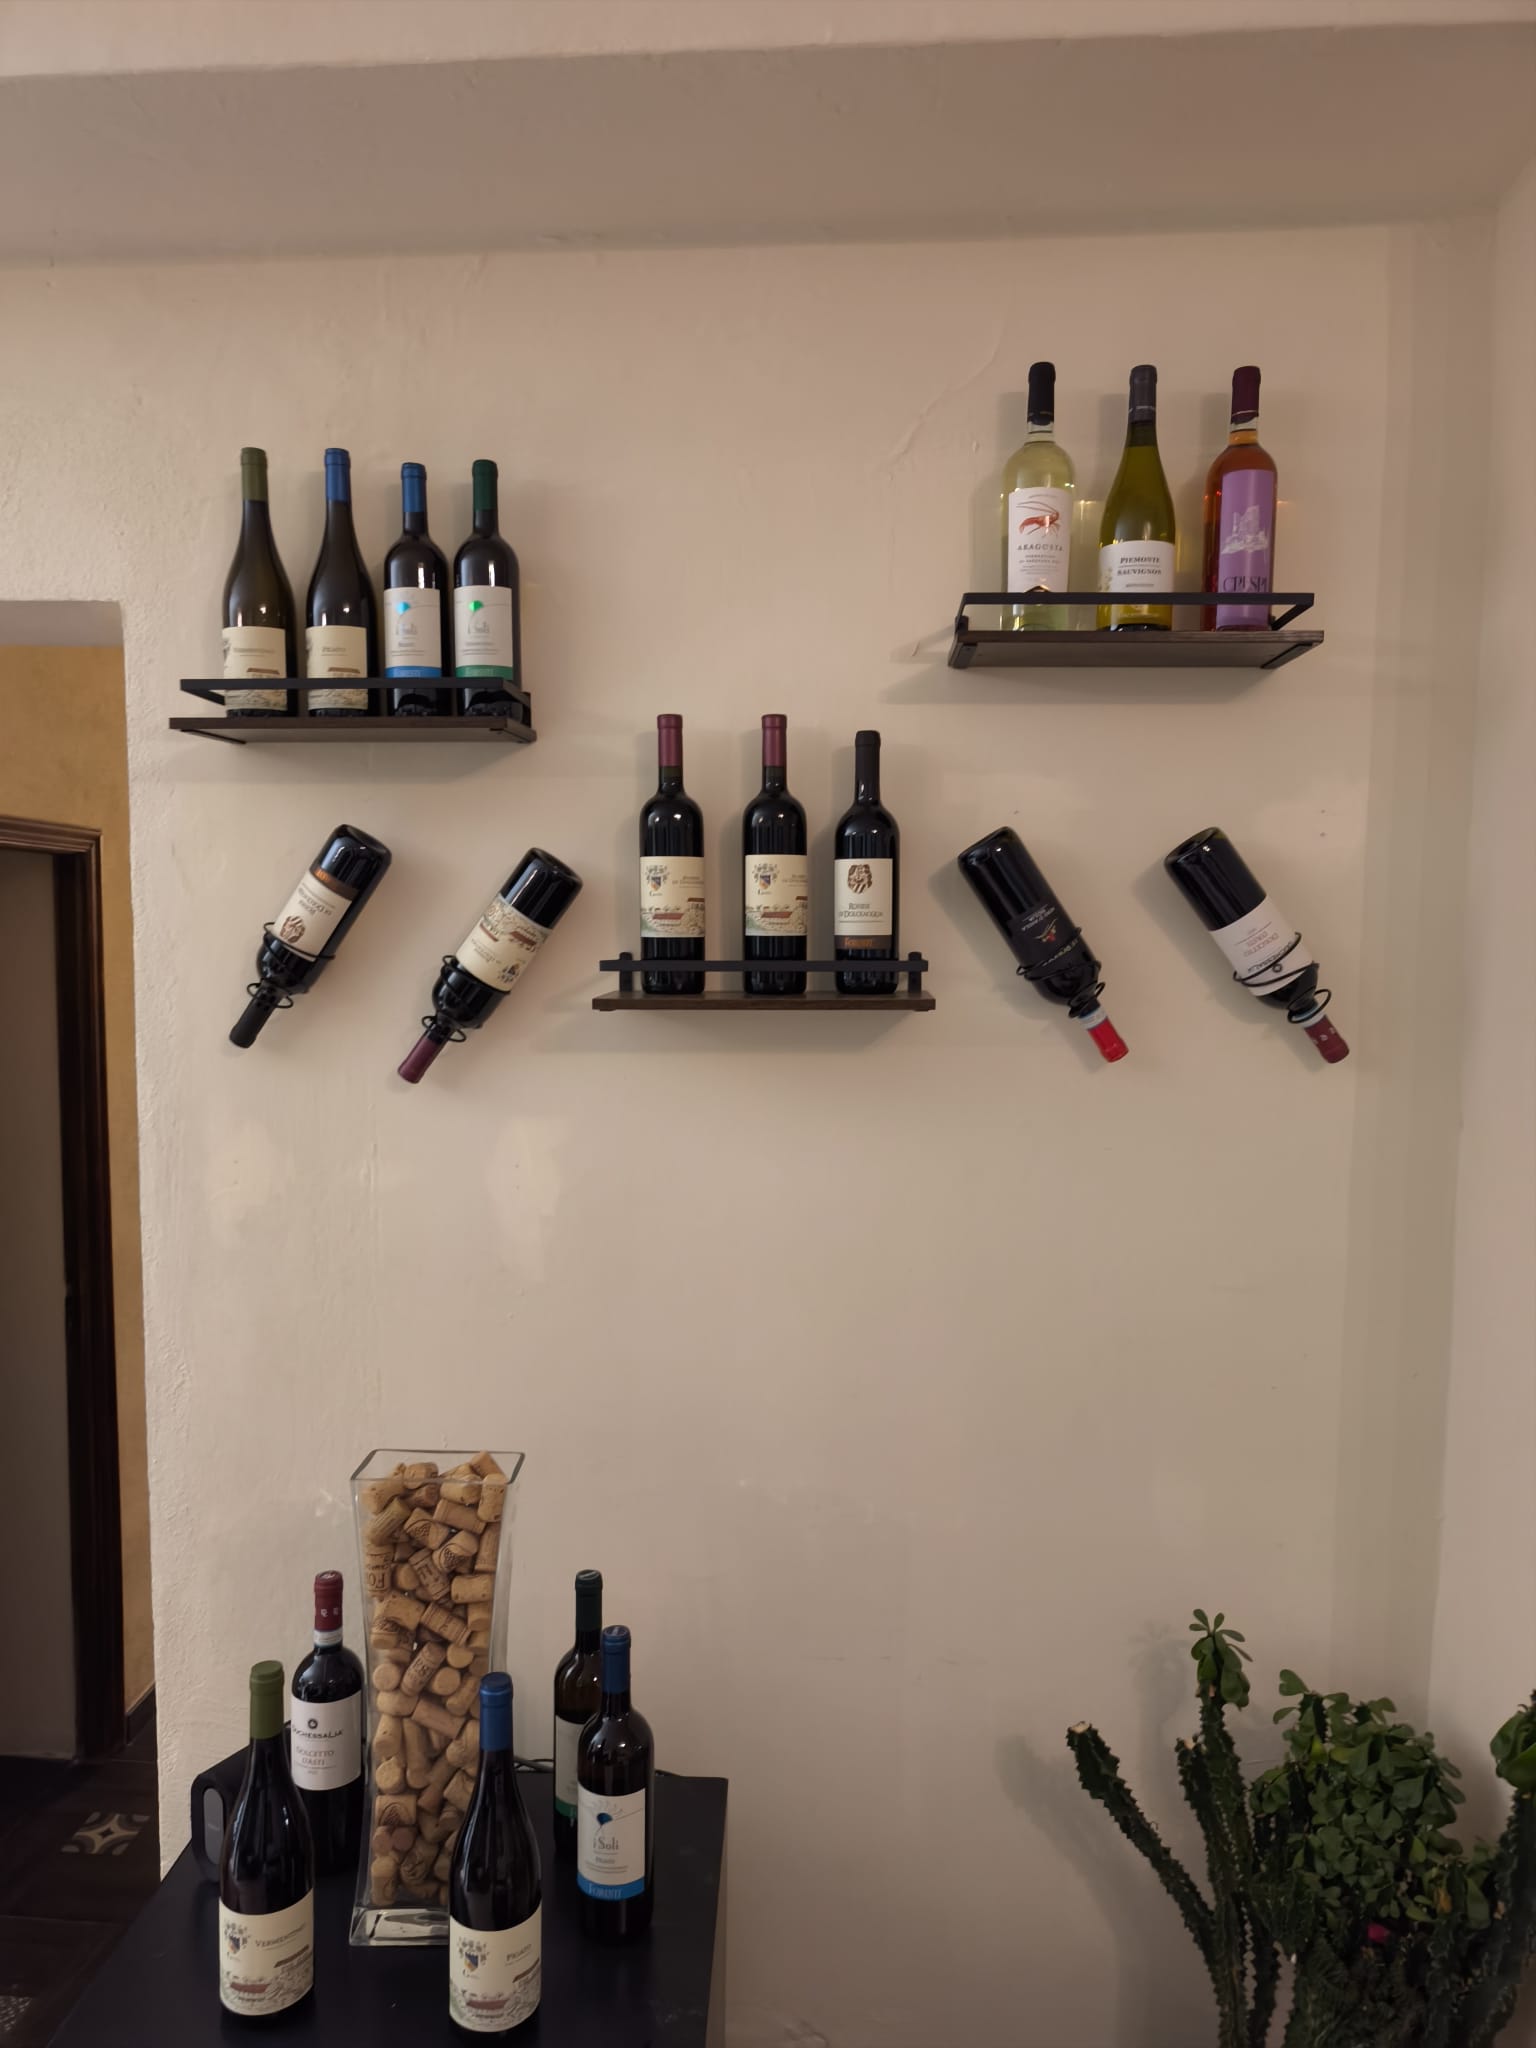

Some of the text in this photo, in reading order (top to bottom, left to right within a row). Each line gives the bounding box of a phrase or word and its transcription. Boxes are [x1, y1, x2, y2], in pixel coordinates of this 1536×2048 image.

[1017, 543, 1063, 552] ARAGOSTA
[1117, 568, 1162, 576] SAUVIGNON
[598, 1836, 620, 1850] Soli
